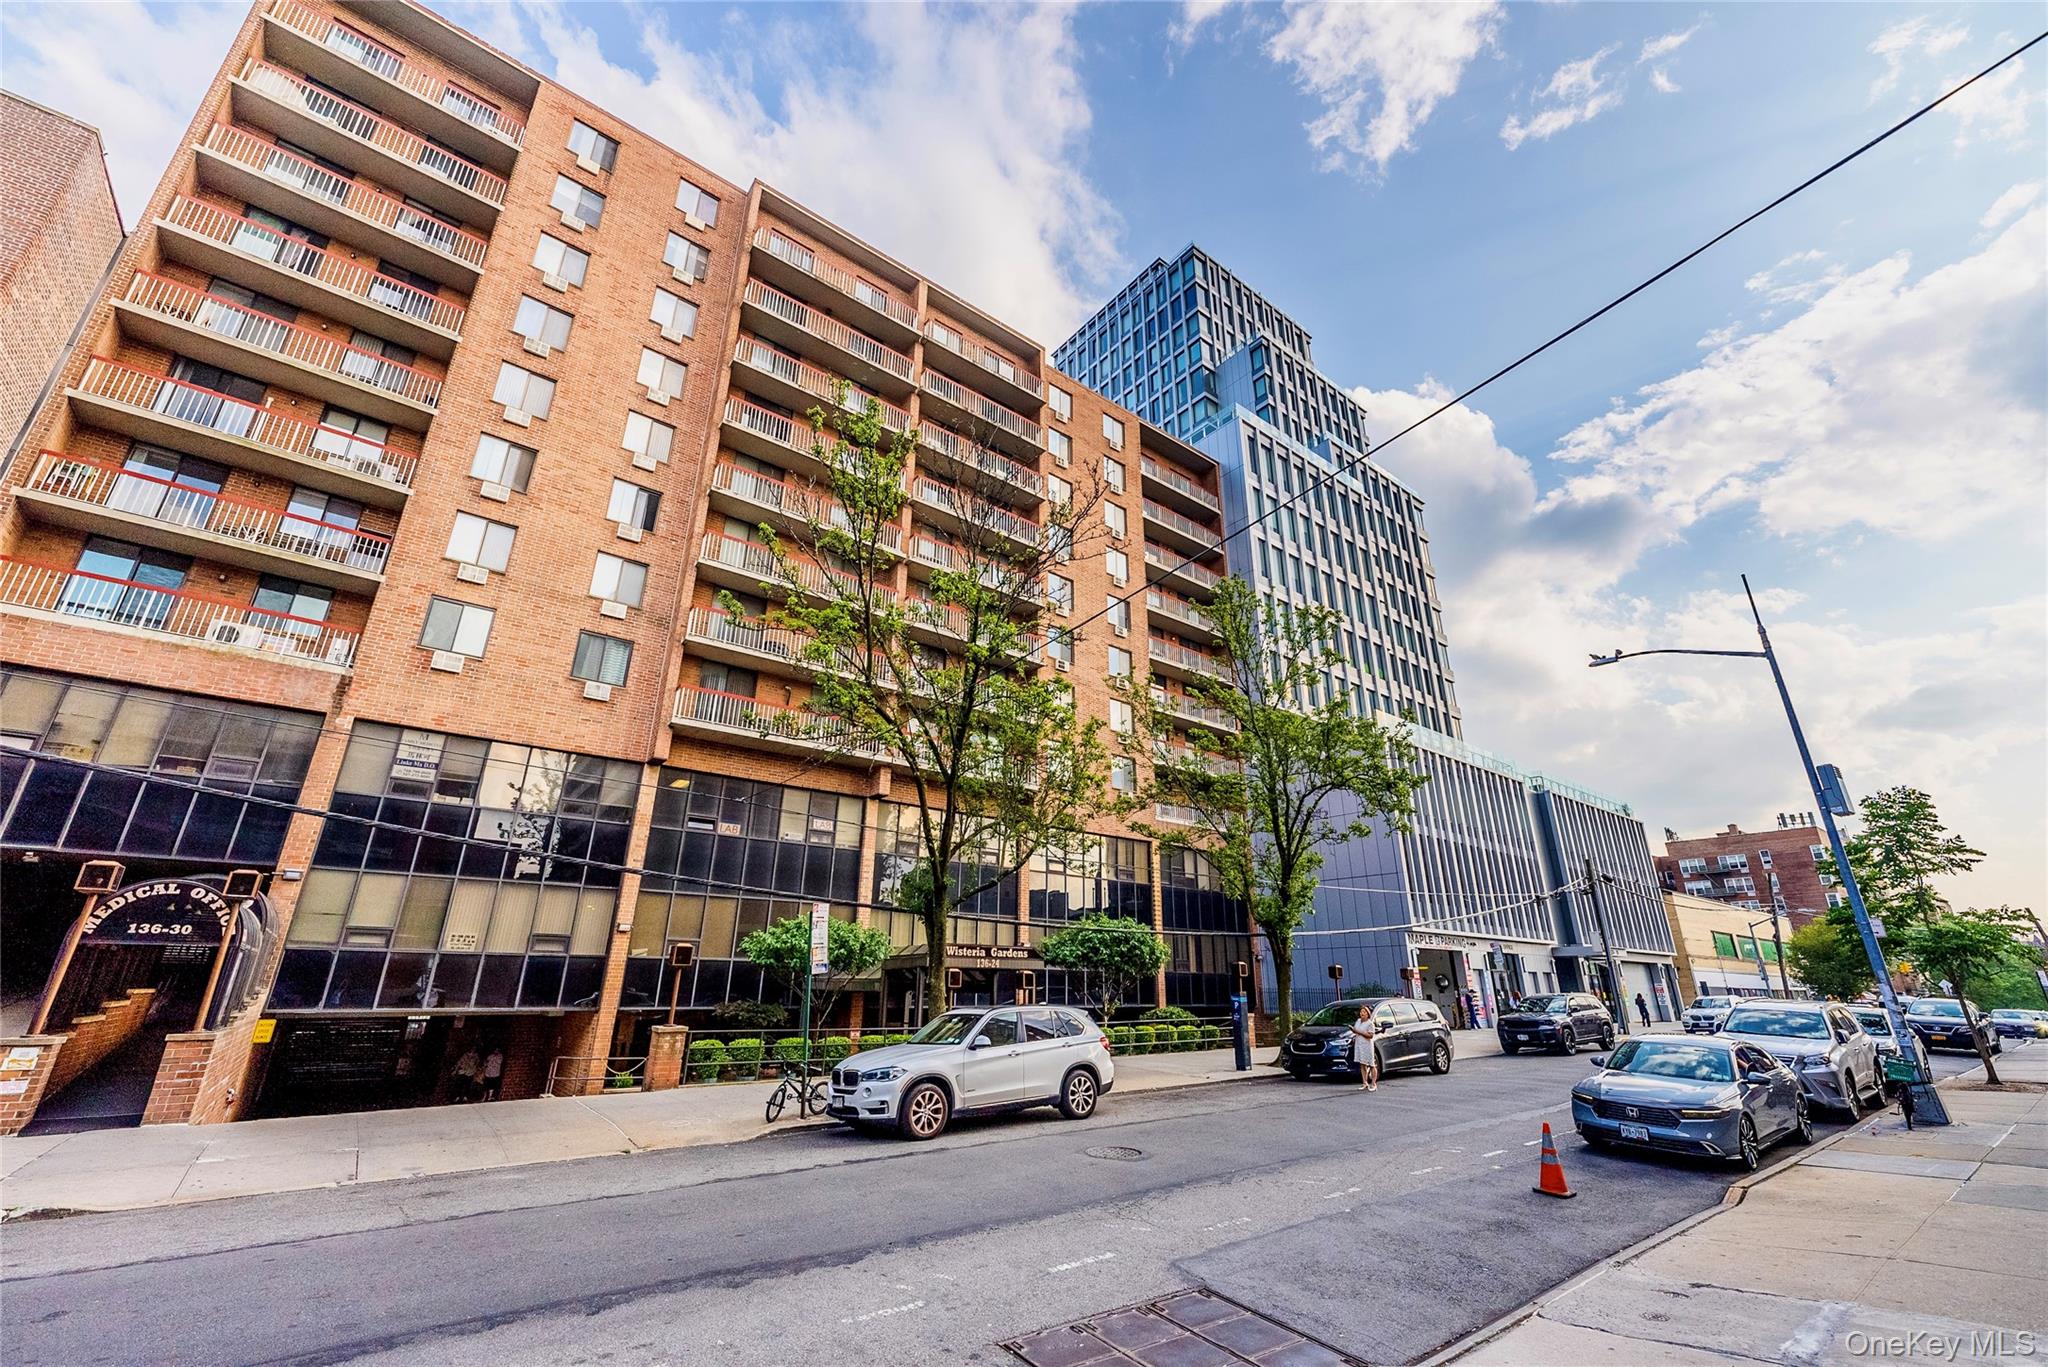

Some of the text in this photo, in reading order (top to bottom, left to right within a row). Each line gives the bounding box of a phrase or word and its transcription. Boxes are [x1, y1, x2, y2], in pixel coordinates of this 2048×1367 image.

[720, 824, 738, 834] LAB
[815, 820, 833, 829] LAB
[82, 883, 181, 935] MEDICAL
[127, 923, 193, 935] 136-30
[1407, 933, 1434, 945] MAPLE
[1440, 935, 1467, 949] PARKING
[946, 946, 1029, 958] Wisteria Gardens
[976, 958, 1000, 968] 136-24
